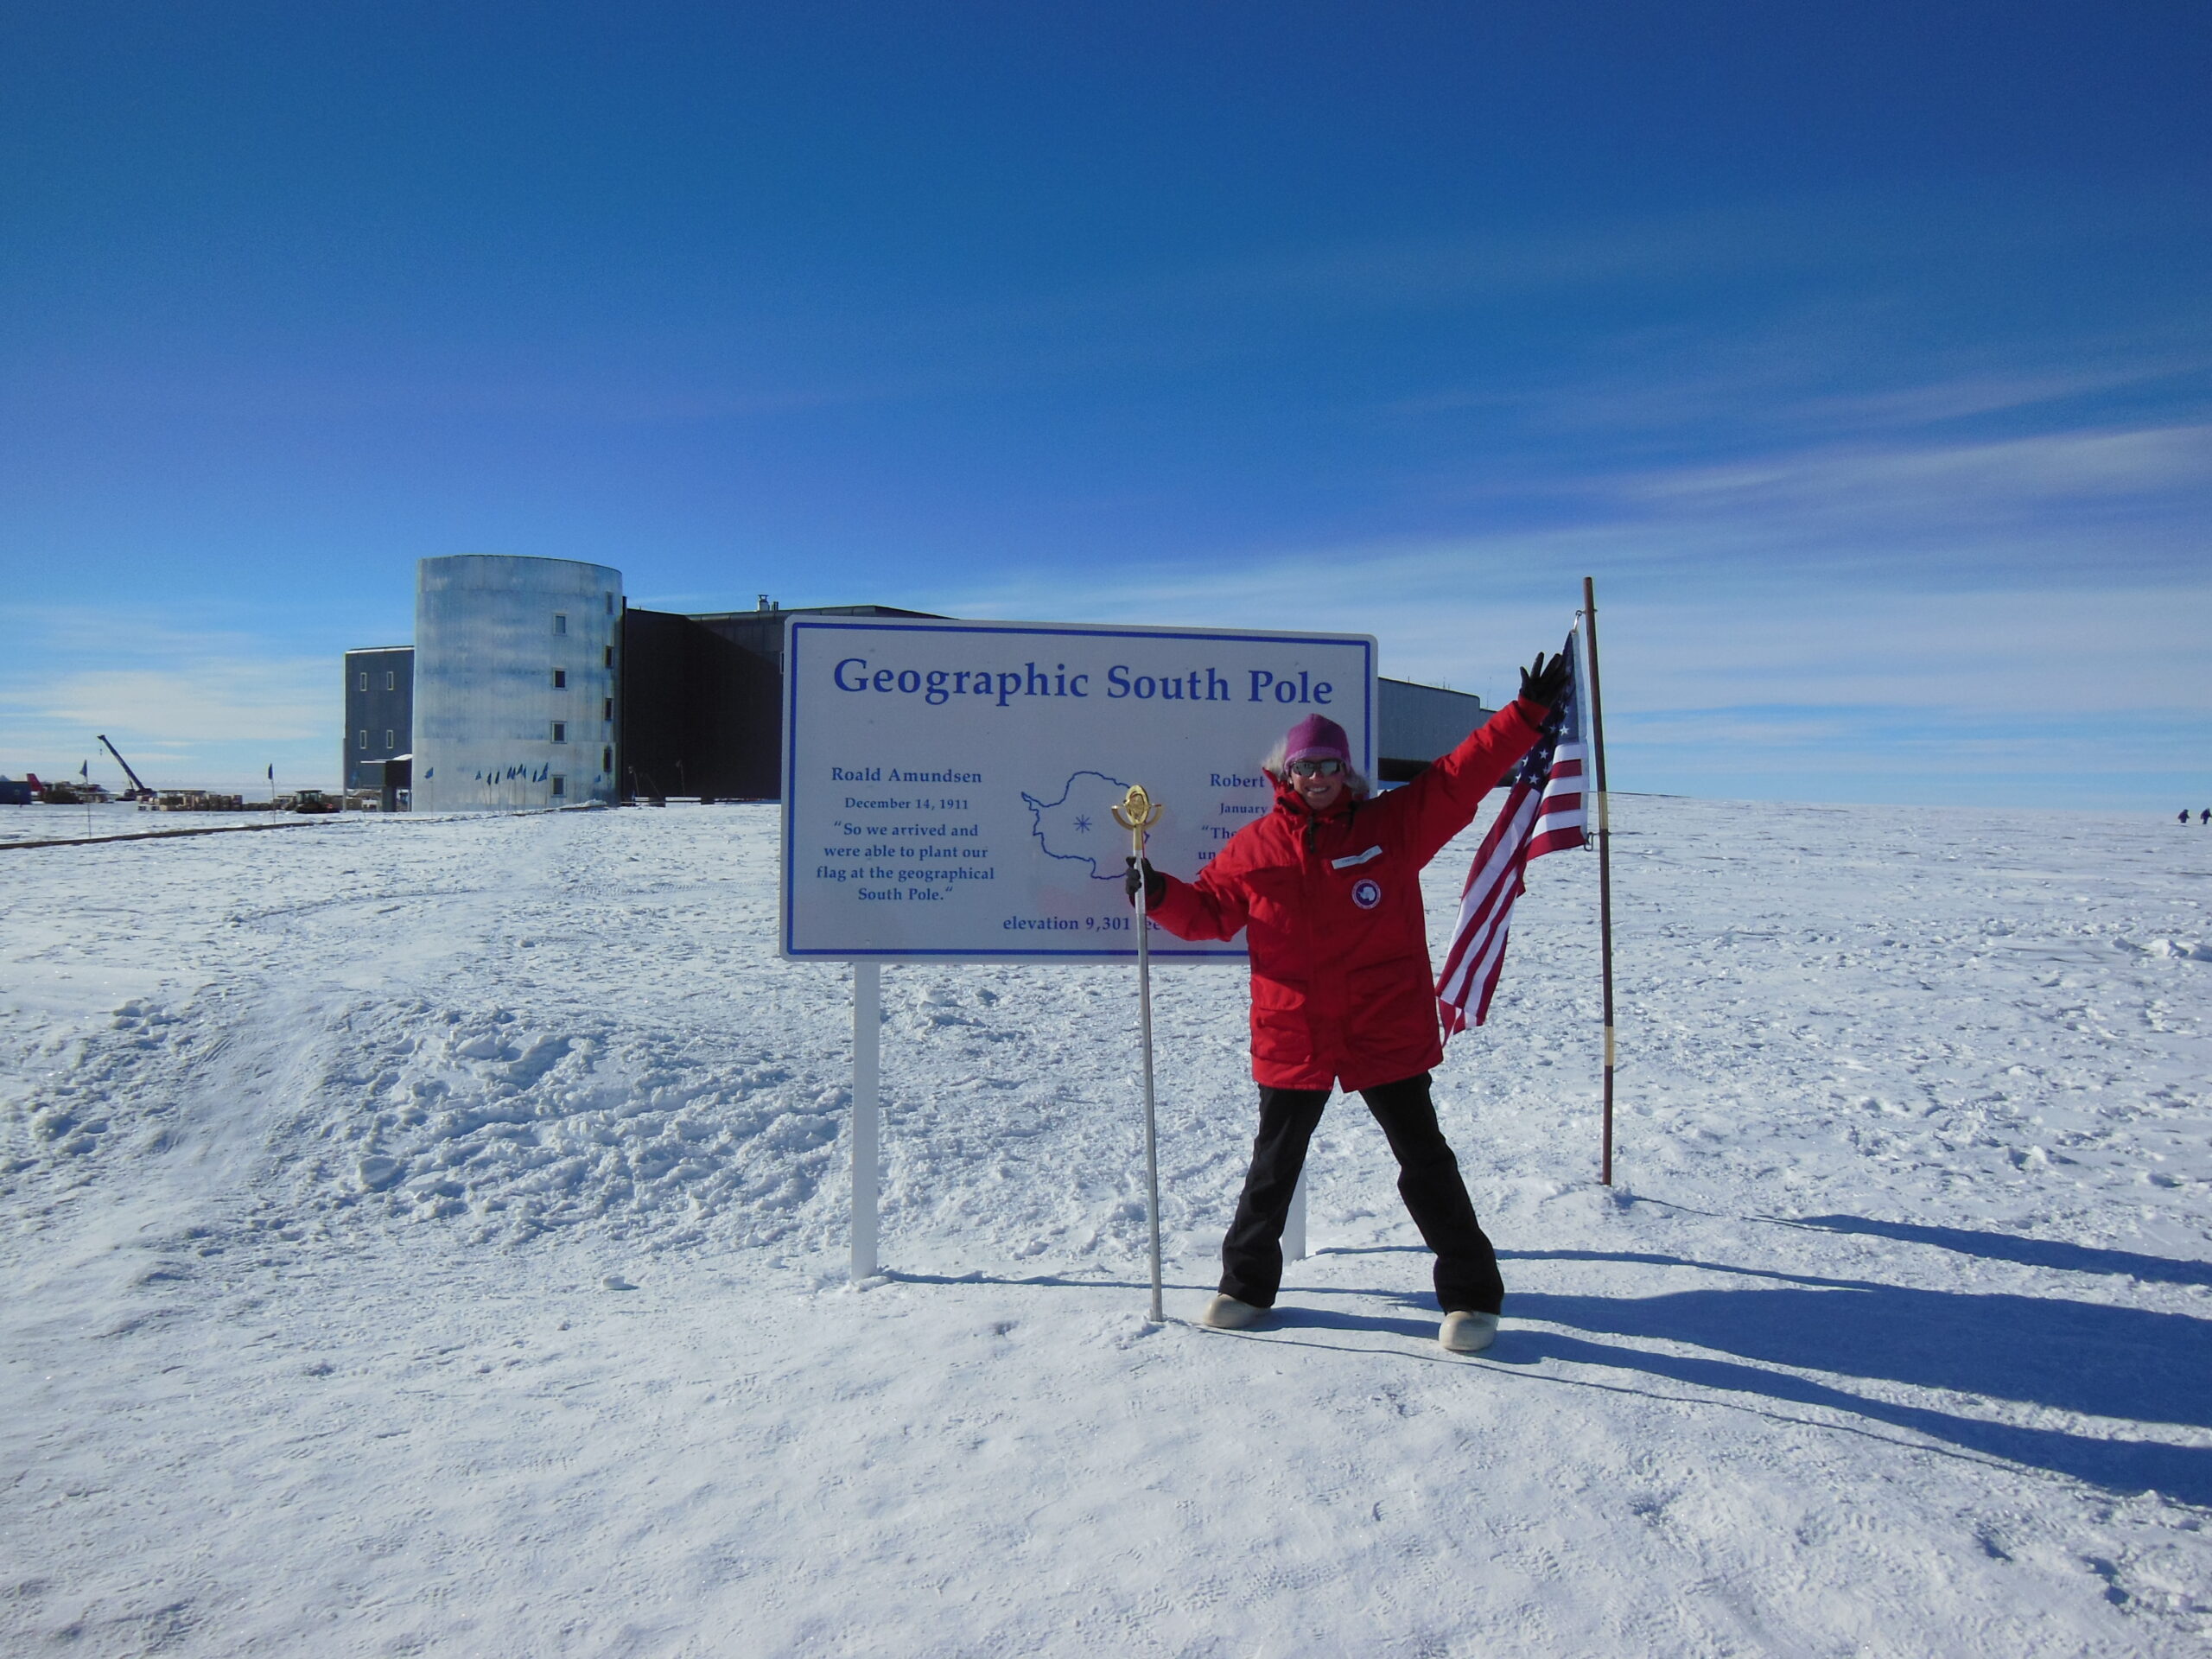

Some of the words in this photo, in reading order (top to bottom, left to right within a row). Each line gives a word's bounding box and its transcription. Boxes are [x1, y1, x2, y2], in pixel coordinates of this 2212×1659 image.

[834, 658, 1089, 707] Geographic
[1107, 665, 1230, 701] South
[1248, 670, 1332, 704] Pole
[831, 767, 881, 781] Roald
[888, 768, 982, 783] Amundsen
[1211, 773, 1266, 788] Robert
[845, 798, 911, 809] December
[916, 799, 935, 810] 14,
[940, 799, 968, 810] 1911
[1219, 803, 1268, 817] January
[867, 827, 887, 836] we
[892, 824, 946, 836] arrived
[951, 824, 978, 836] and
[823, 848, 861, 856] were
[865, 845, 895, 857] able
[900, 846, 914, 857] to
[919, 845, 957, 861] plant
[963, 849, 988, 857] our
[817, 866, 846, 882] flag
[851, 868, 864, 879] at
[870, 866, 893, 879] the
[899, 867, 995, 883] geographical
[858, 887, 902, 900] South
[1003, 916, 1078, 931] elevation
[1085, 917, 1129, 932] 9,301
